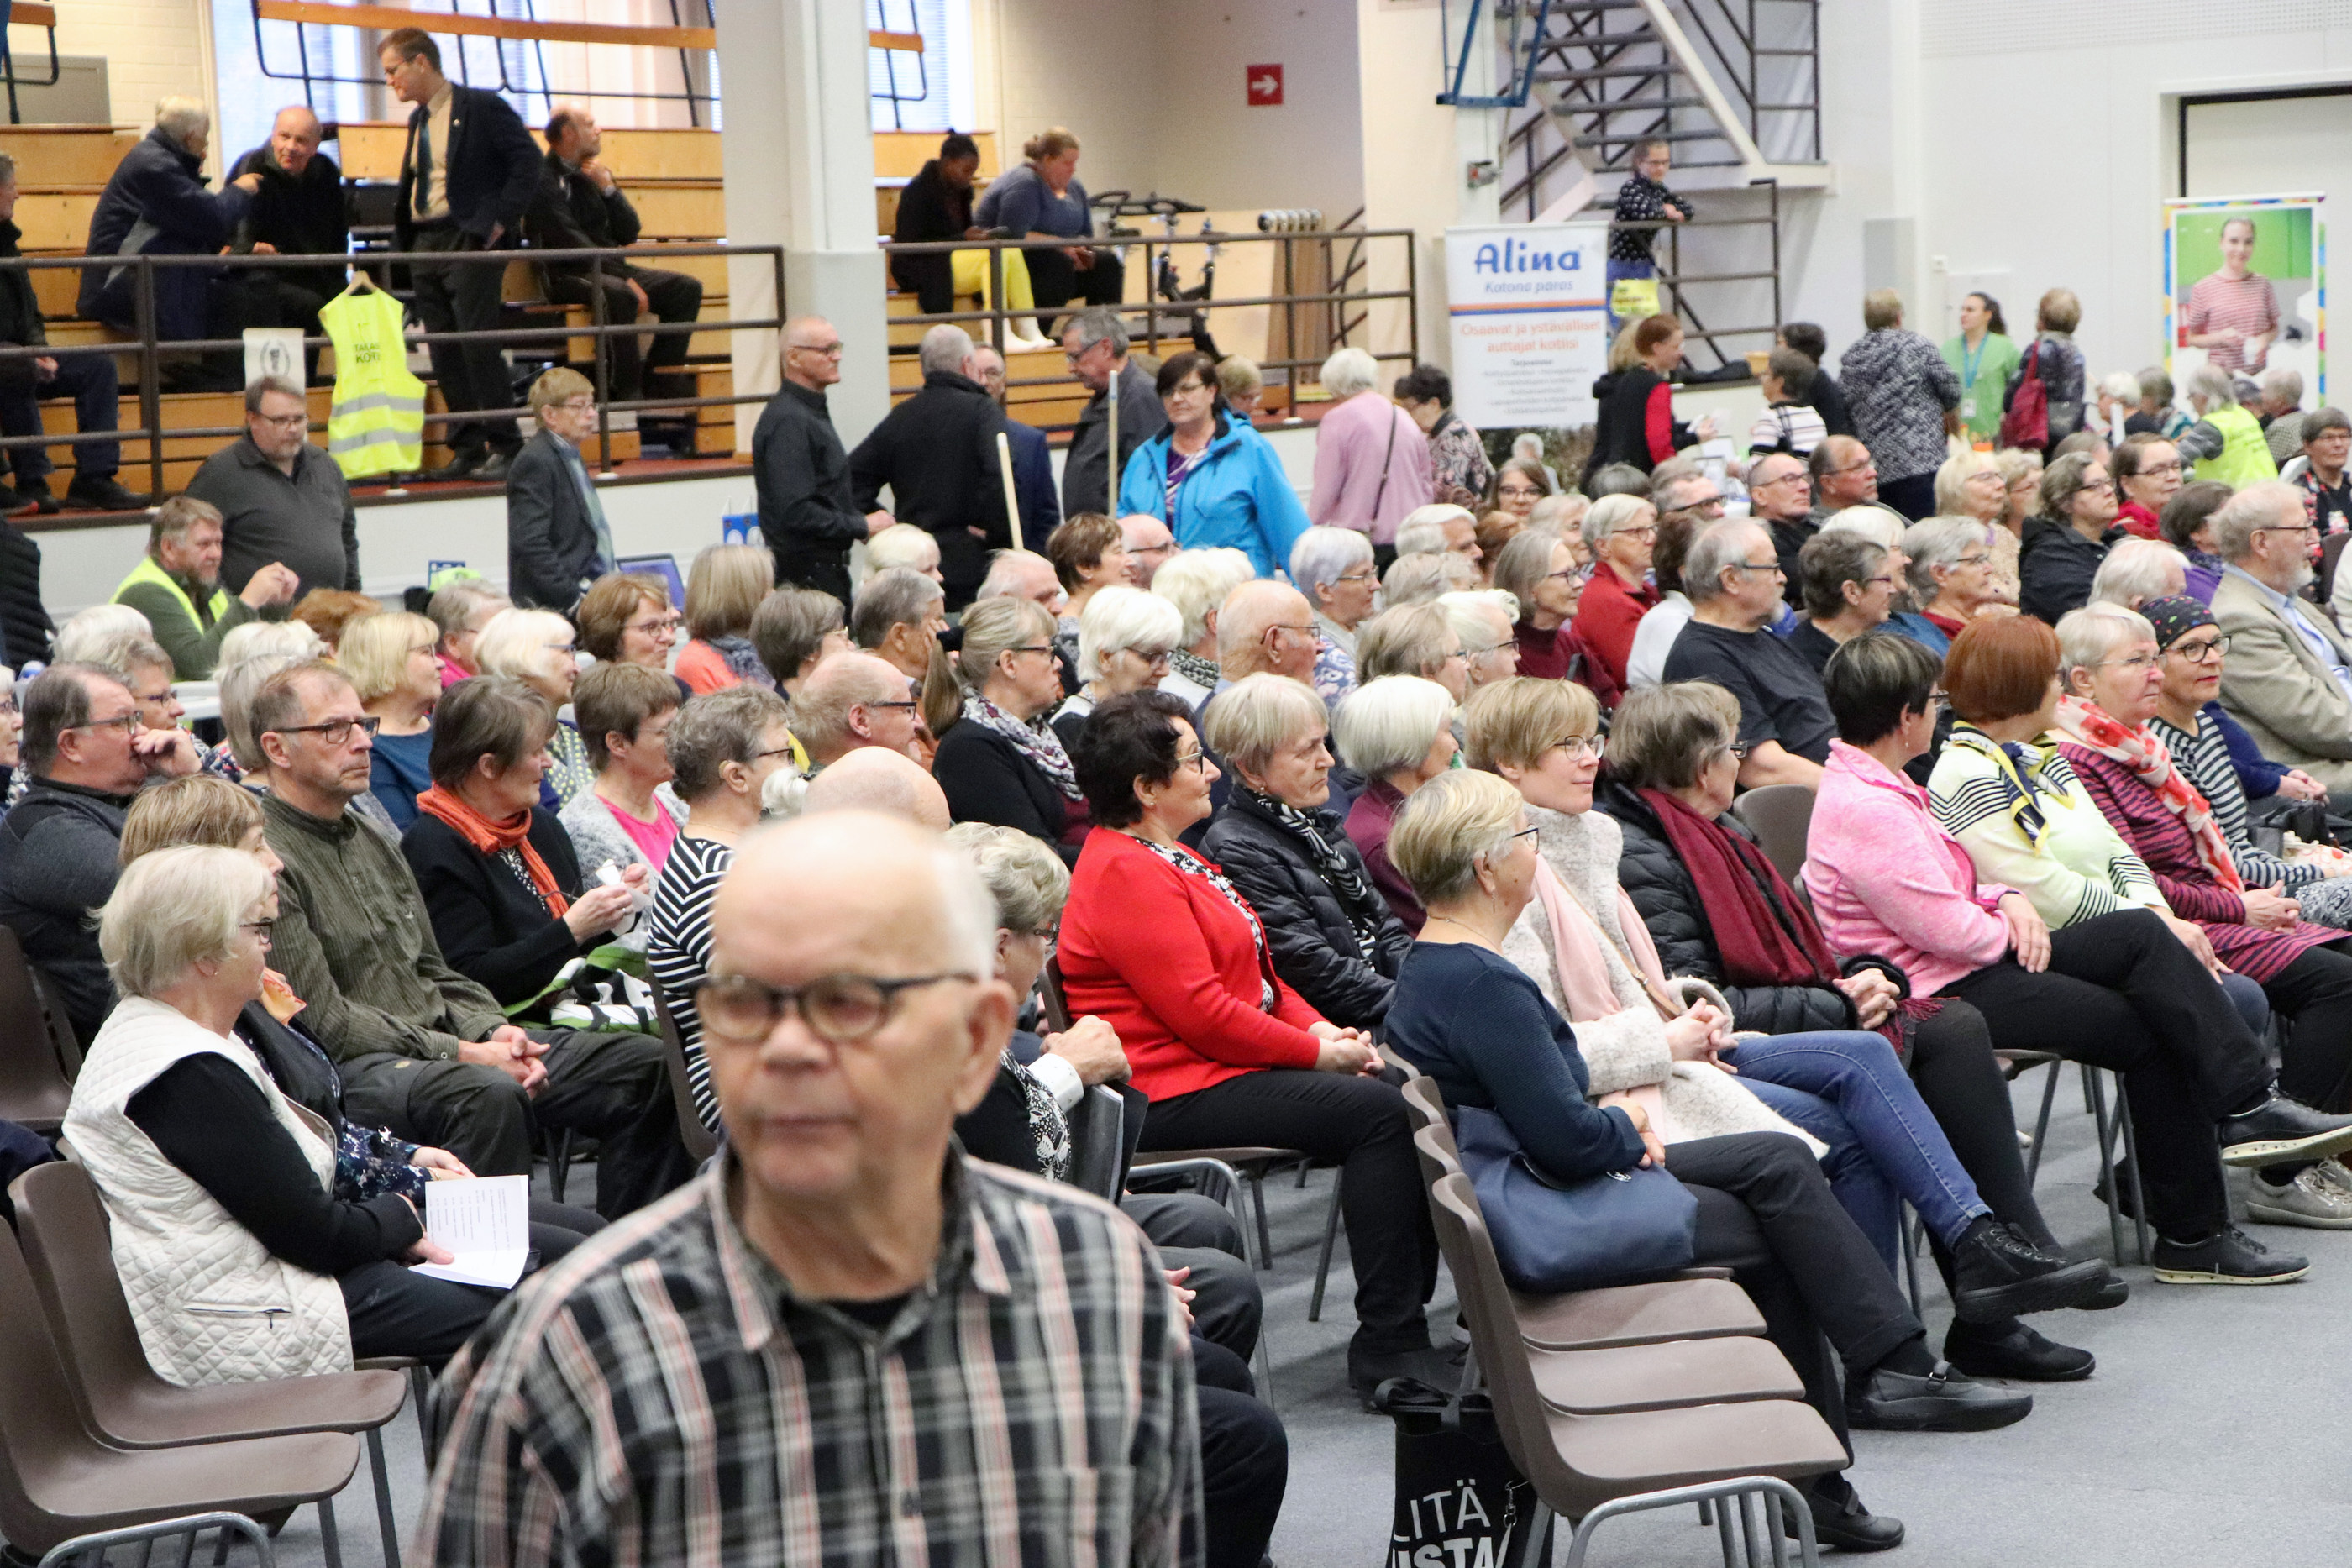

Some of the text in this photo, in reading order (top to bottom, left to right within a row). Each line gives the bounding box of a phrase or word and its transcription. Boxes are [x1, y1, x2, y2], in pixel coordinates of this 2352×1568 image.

[1474, 237, 1580, 274] Alina
[1461, 323, 1512, 337] Osaavat
[1515, 323, 1527, 336] ja
